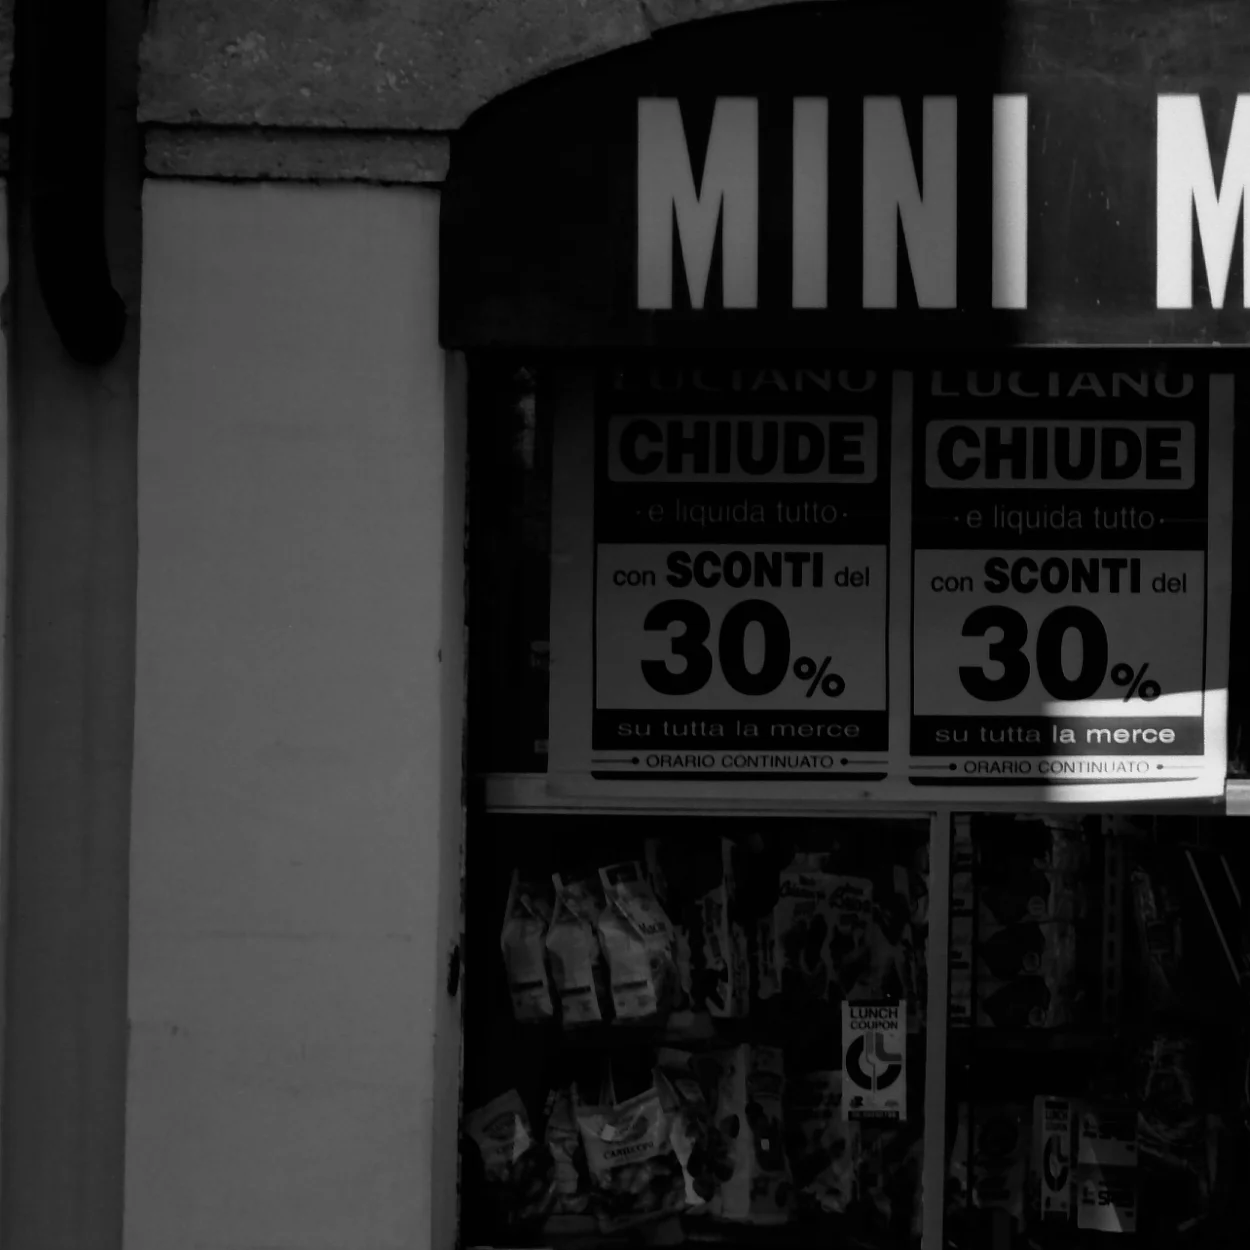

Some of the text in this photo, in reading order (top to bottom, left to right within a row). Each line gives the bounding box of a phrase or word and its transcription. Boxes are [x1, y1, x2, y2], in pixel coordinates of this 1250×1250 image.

[638, 93, 1028, 309] MINI
[620, 419, 865, 475] CHIUDE
[937, 426, 1181, 480] CHIUDE
[648, 498, 837, 530] e liquida tutto
[966, 504, 1155, 536] e liquida tutto
[614, 551, 869, 587] con SCONTI del
[931, 557, 1186, 593] con SCONTI del
[617, 720, 860, 738] su tutta la merce
[935, 724, 1176, 744] su tutta la merce
[646, 755, 834, 769] ORARIO CONTINUATO
[963, 761, 1150, 775] ORARIO CONTINUATO
[850, 1008, 898, 1018] LUNCH
[850, 1021, 898, 1030] COUPON
